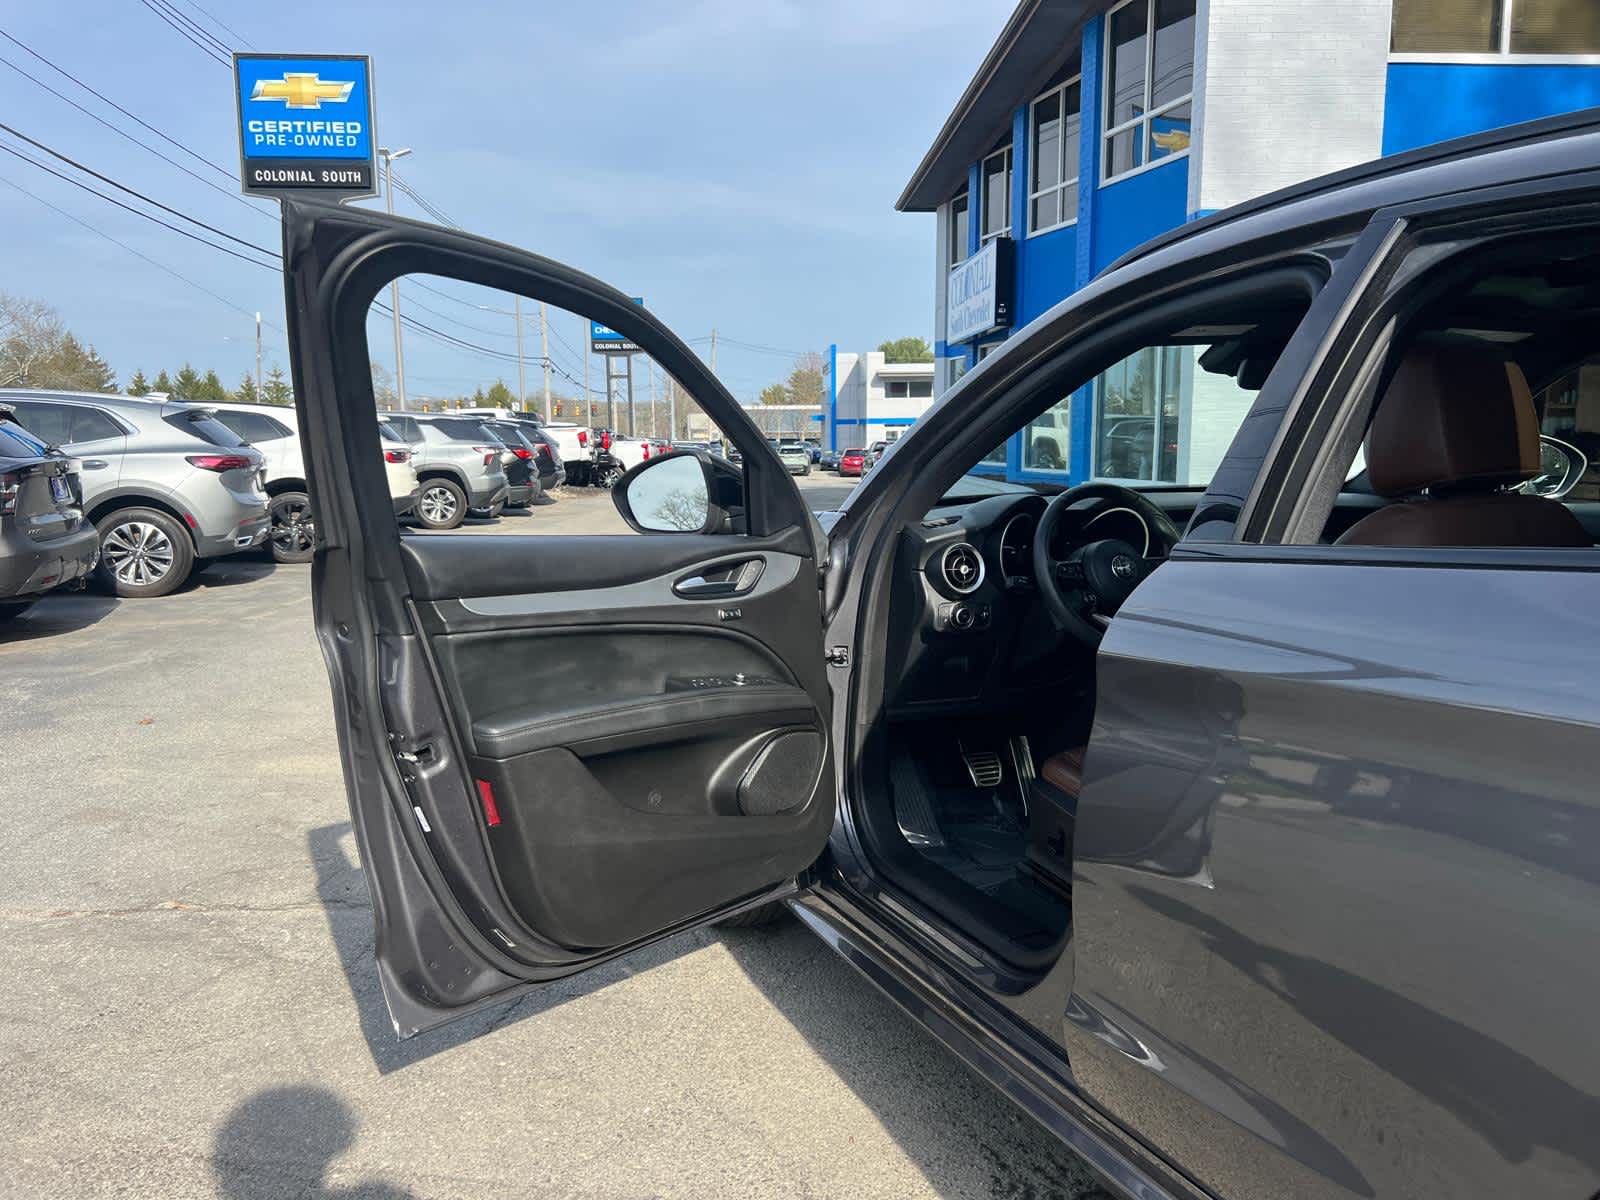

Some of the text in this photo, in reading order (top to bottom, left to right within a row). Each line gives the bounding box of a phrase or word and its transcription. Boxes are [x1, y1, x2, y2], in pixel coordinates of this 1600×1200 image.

[248, 120, 361, 133] CERTIFIED
[255, 134, 357, 146] PRE-OWNED
[255, 169, 361, 182] COLONIAL SOUTH
